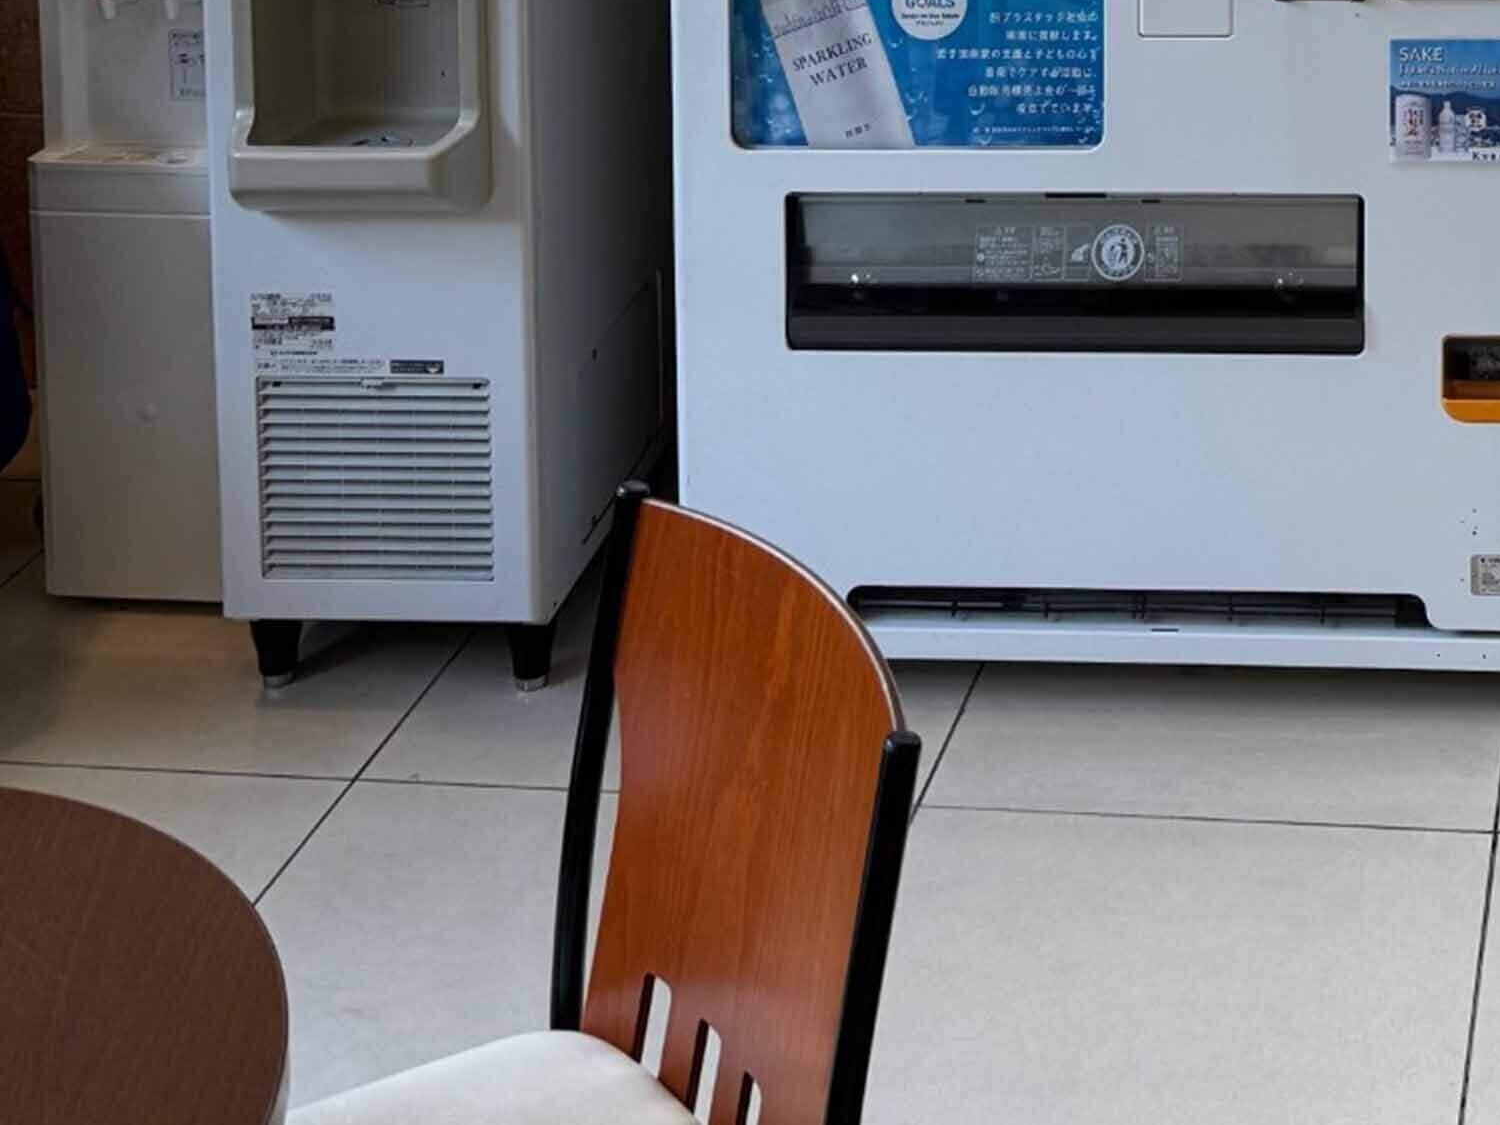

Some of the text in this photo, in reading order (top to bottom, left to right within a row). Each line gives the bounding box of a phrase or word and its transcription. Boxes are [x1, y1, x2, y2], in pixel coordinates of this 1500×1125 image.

[792, 32, 873, 73] SPARKLING
[1400, 46, 1444, 62] SAKE
[809, 57, 868, 88] WATER
